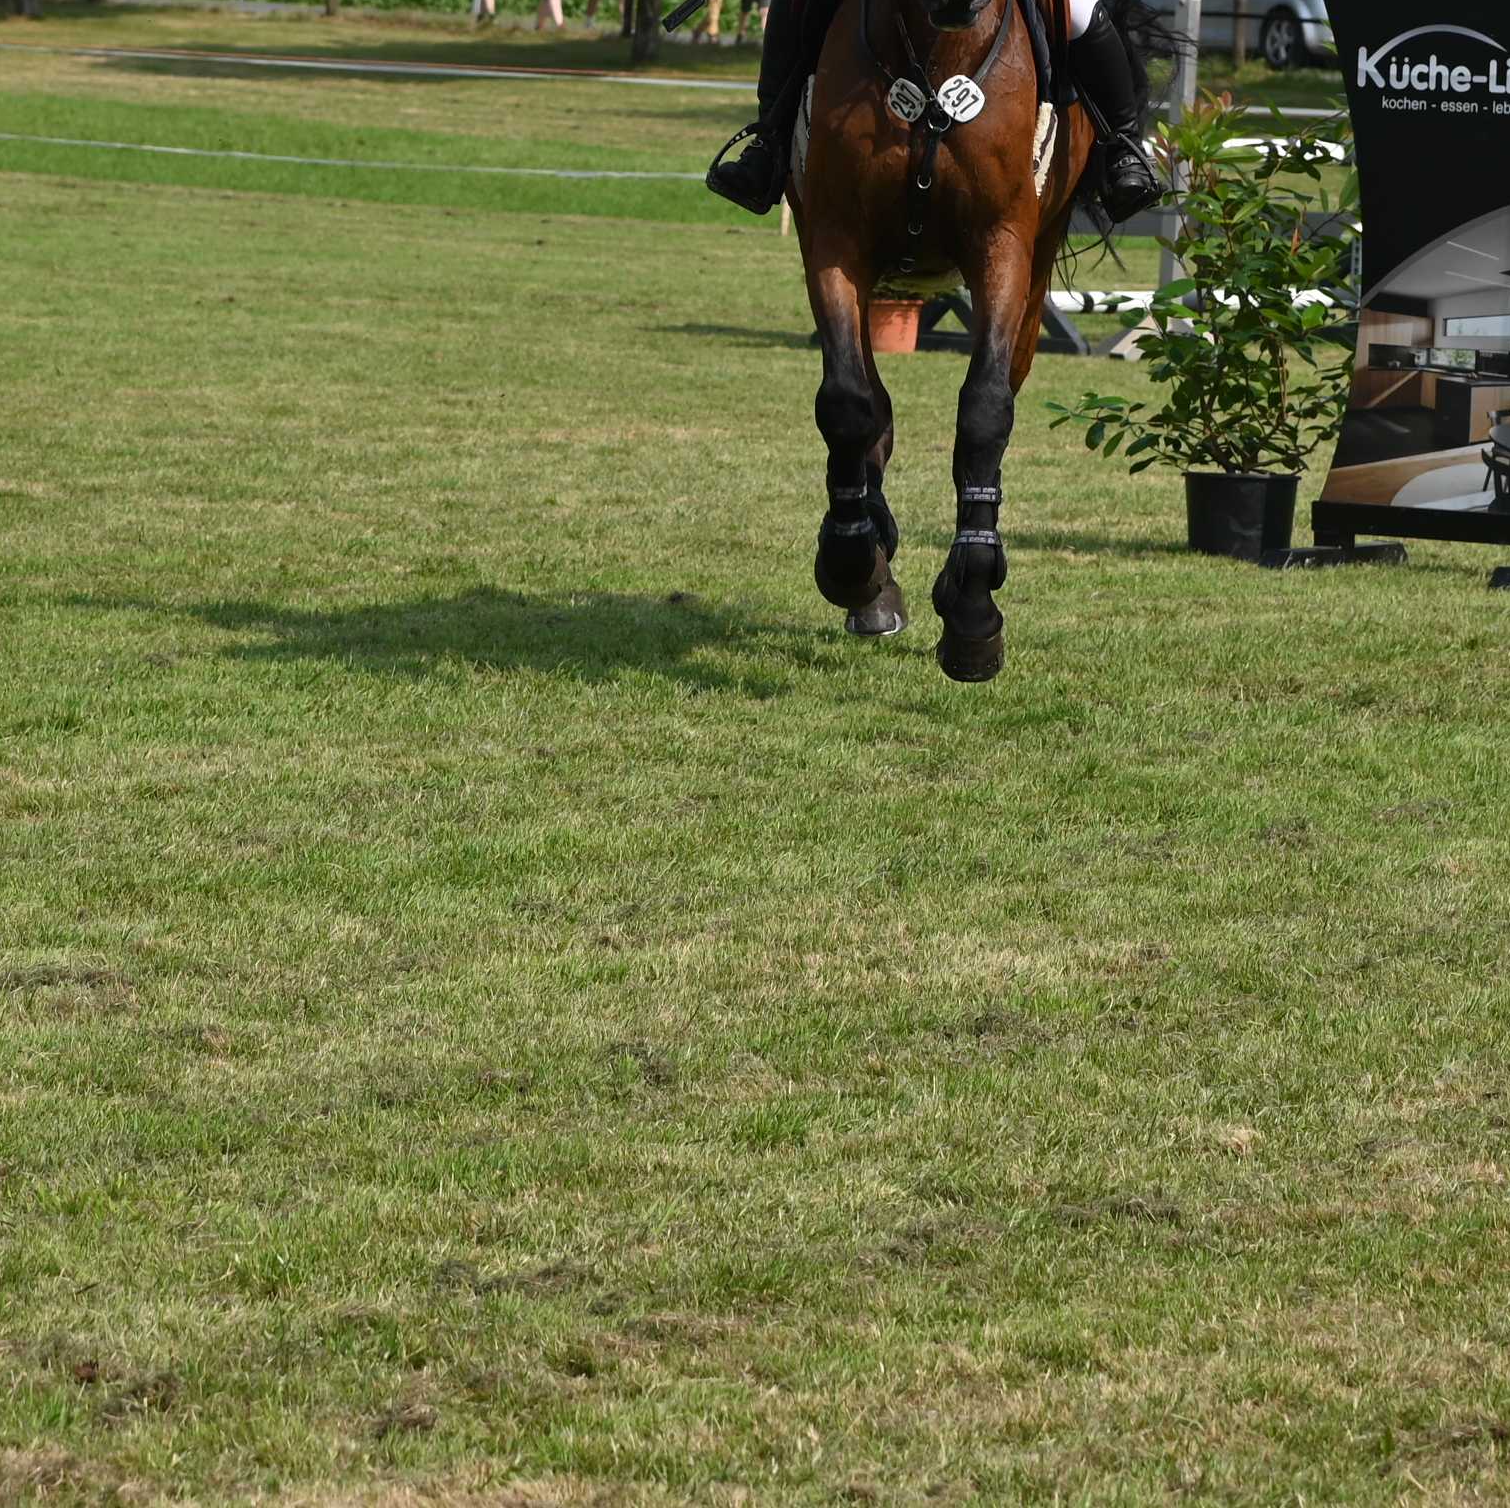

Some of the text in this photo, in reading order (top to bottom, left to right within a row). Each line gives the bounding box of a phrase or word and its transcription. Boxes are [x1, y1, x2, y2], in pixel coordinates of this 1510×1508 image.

[943, 78, 979, 114] 297
[1381, 96, 1427, 111] kochen
[1441, 101, 1478, 113] essen
